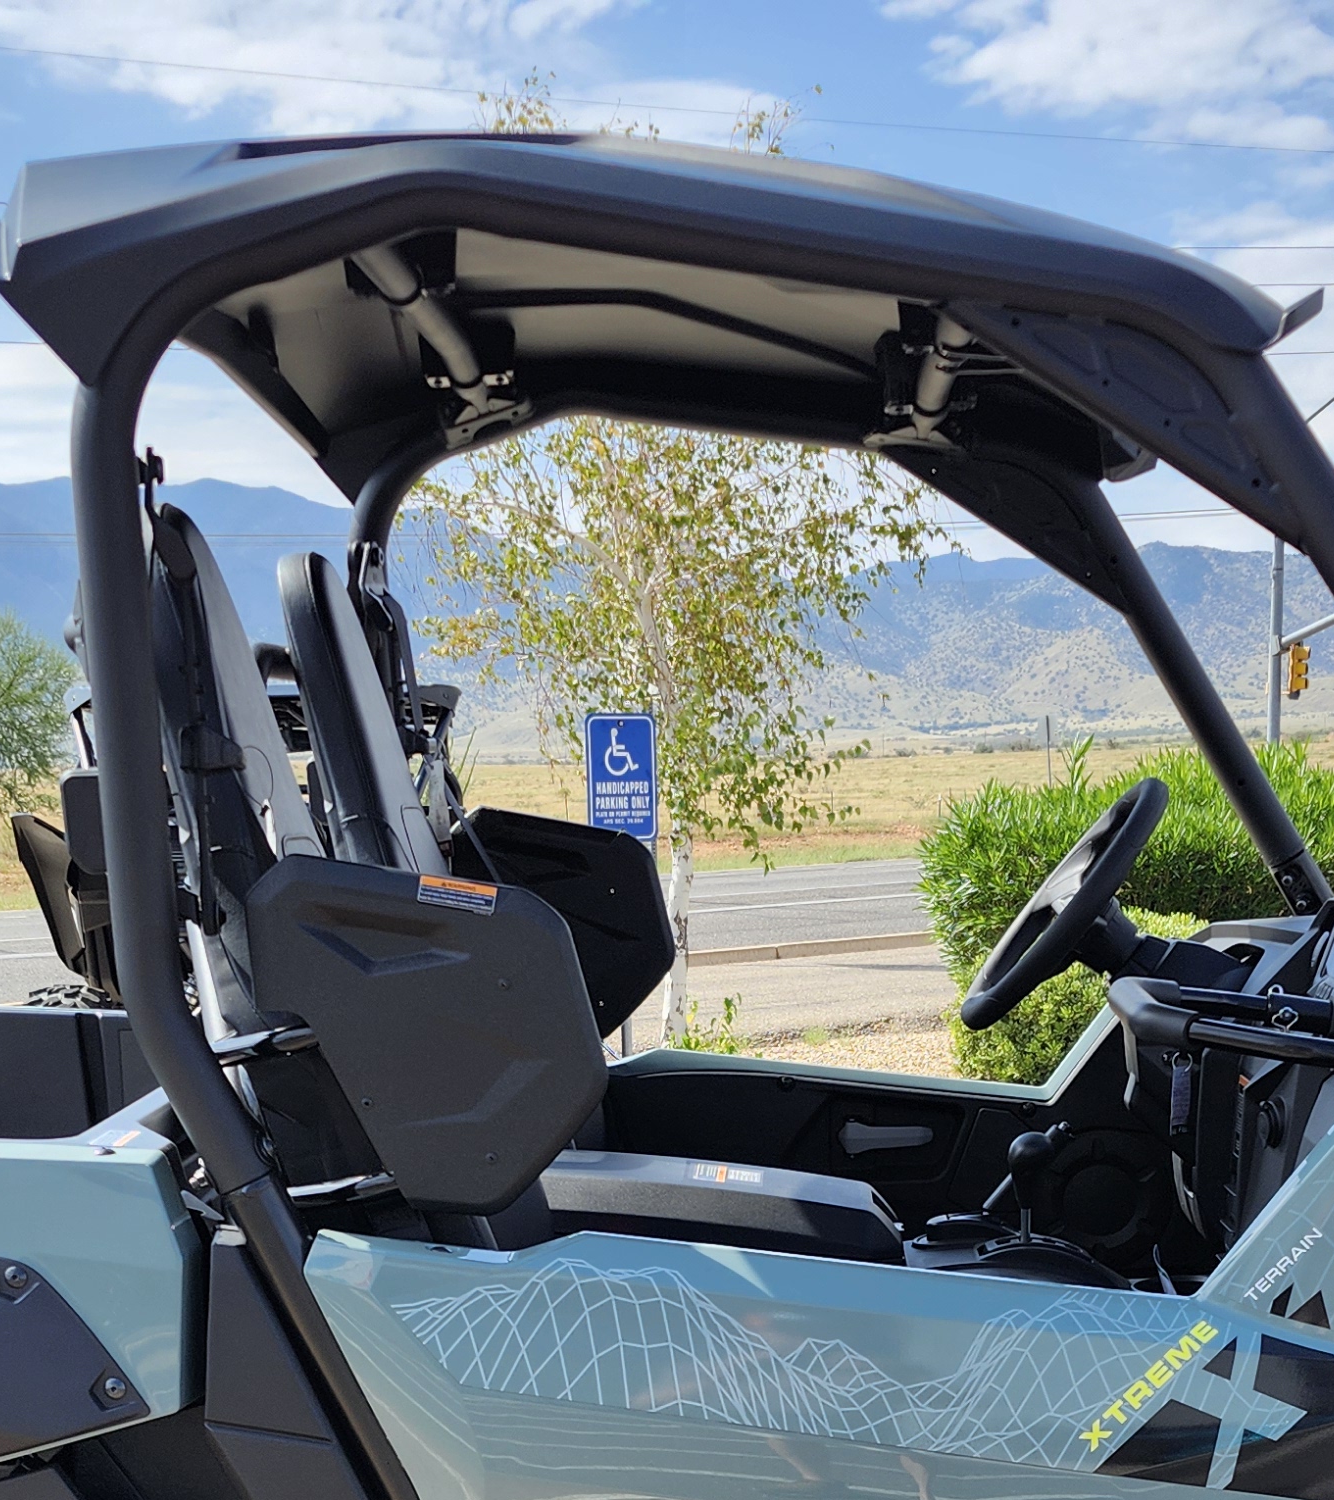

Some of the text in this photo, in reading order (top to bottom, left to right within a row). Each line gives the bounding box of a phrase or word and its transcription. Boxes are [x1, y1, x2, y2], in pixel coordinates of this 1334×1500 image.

[596, 781, 649, 794] HANDICAPPED
[595, 795, 650, 809] PARKING ONLY
[1078, 1226, 1323, 1452] XTREME TERRAIN
